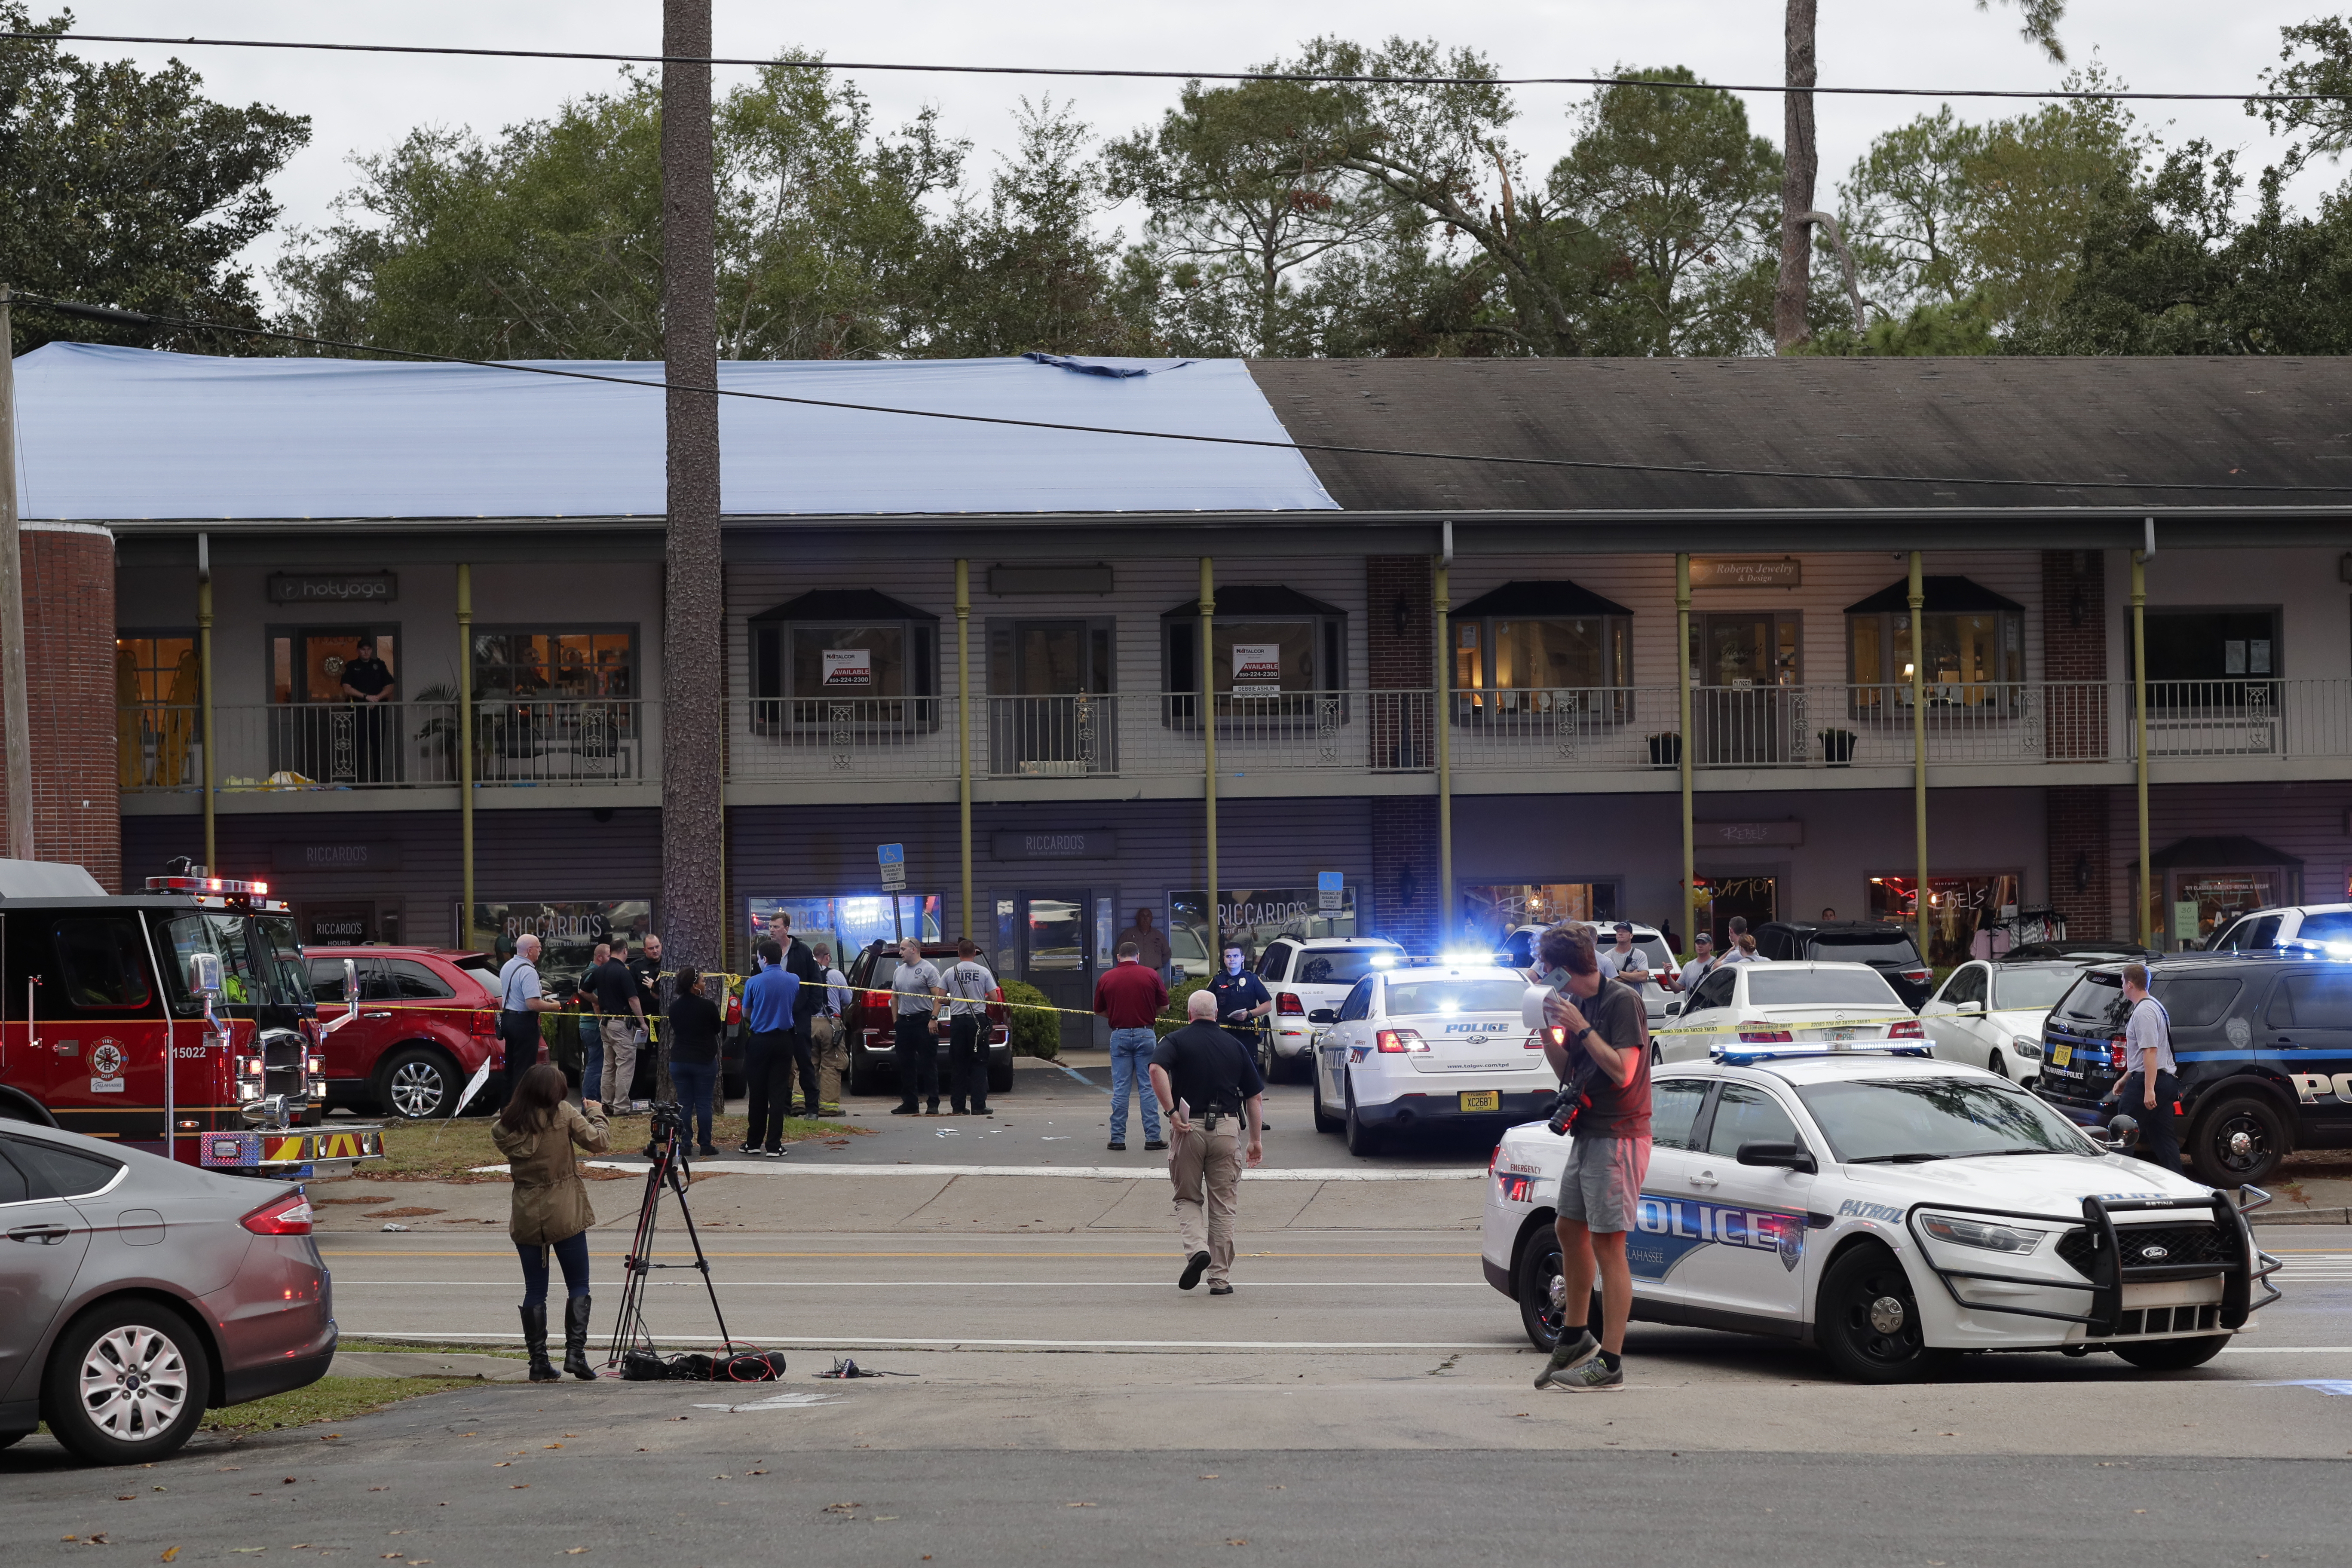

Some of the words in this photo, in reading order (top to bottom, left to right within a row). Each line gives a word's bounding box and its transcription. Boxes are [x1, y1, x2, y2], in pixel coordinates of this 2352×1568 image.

[1717, 564, 1754, 573] Roberts
[1756, 564, 1794, 575] Jewelry
[1747, 574, 1772, 583] Design
[1026, 835, 1084, 850] RICCARDO'S
[307, 845, 367, 861] RICCARDO'S
[1217, 901, 1308, 925] RICCARDO'S
[507, 914, 602, 939] RICCARDO'S
[798, 909, 892, 933] RICCARDO'S
[316, 922, 362, 934] RICCARDO'S
[954, 972, 979, 981] FIRE
[1444, 1023, 1509, 1034] POLICE
[173, 1047, 206, 1059] 15022
[1326, 1050, 1344, 1069] POLICE
[1350, 1049, 1364, 1064] 911
[2067, 1071, 2084, 1079] POLICE
[92, 1081, 122, 1090] TALLAHASSEE
[1467, 1097, 1492, 1107] XC2687
[1510, 1164, 1542, 1175] EMERGENCY
[1511, 1178, 1533, 1203] 911
[1836, 1199, 1906, 1225] PATROL
[1637, 1198, 1780, 1250] OLICE
